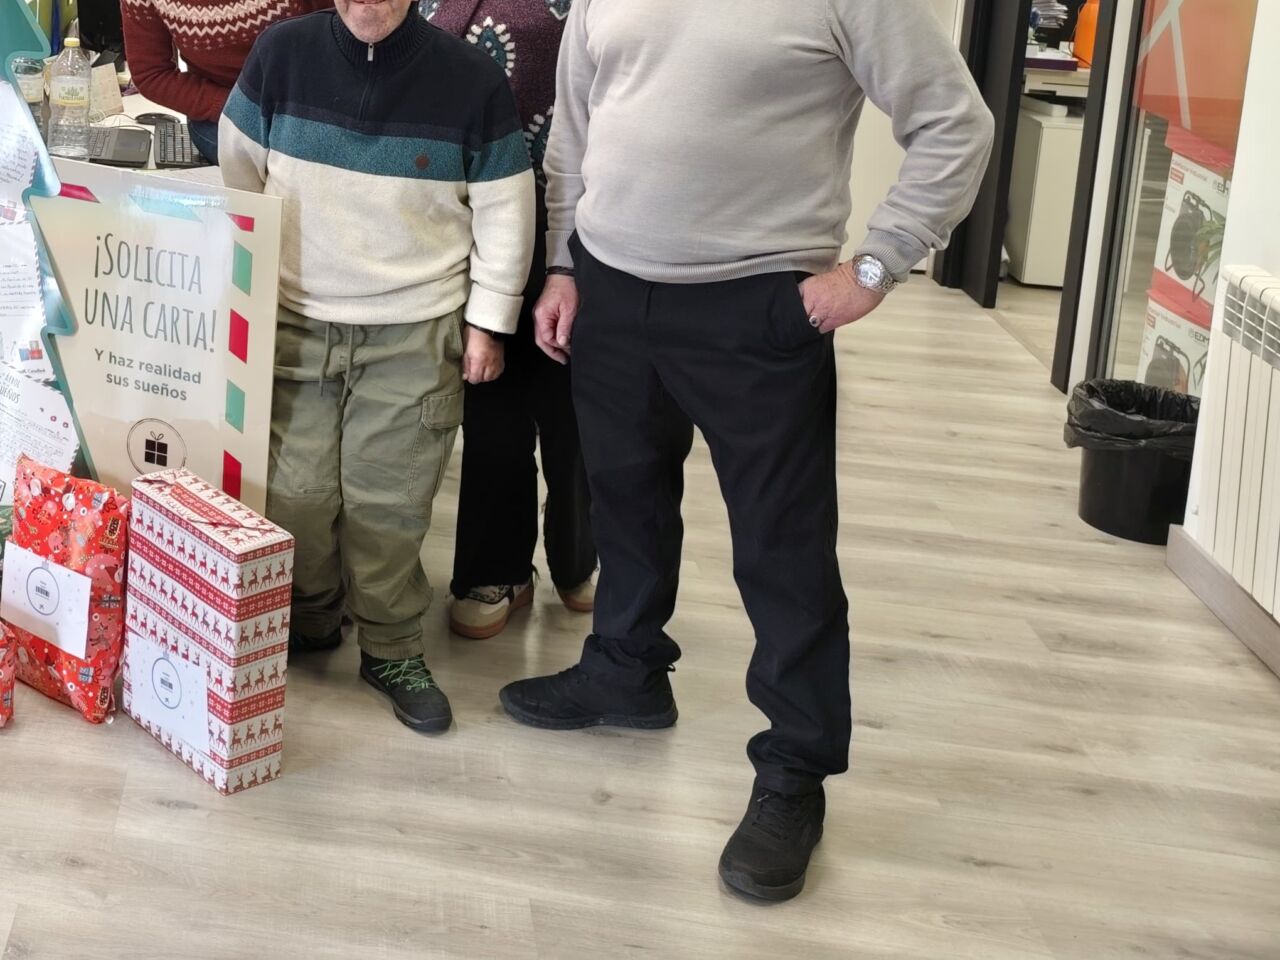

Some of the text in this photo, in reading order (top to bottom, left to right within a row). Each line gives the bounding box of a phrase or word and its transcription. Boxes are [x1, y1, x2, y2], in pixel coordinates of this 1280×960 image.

[94, 233, 202, 295] ¡SOLICITA
[84, 287, 133, 334] UNA
[143, 301, 217, 353] CARTA!
[94, 348, 202, 385] Y haz realidad
[106, 372, 188, 401] sus sueños
